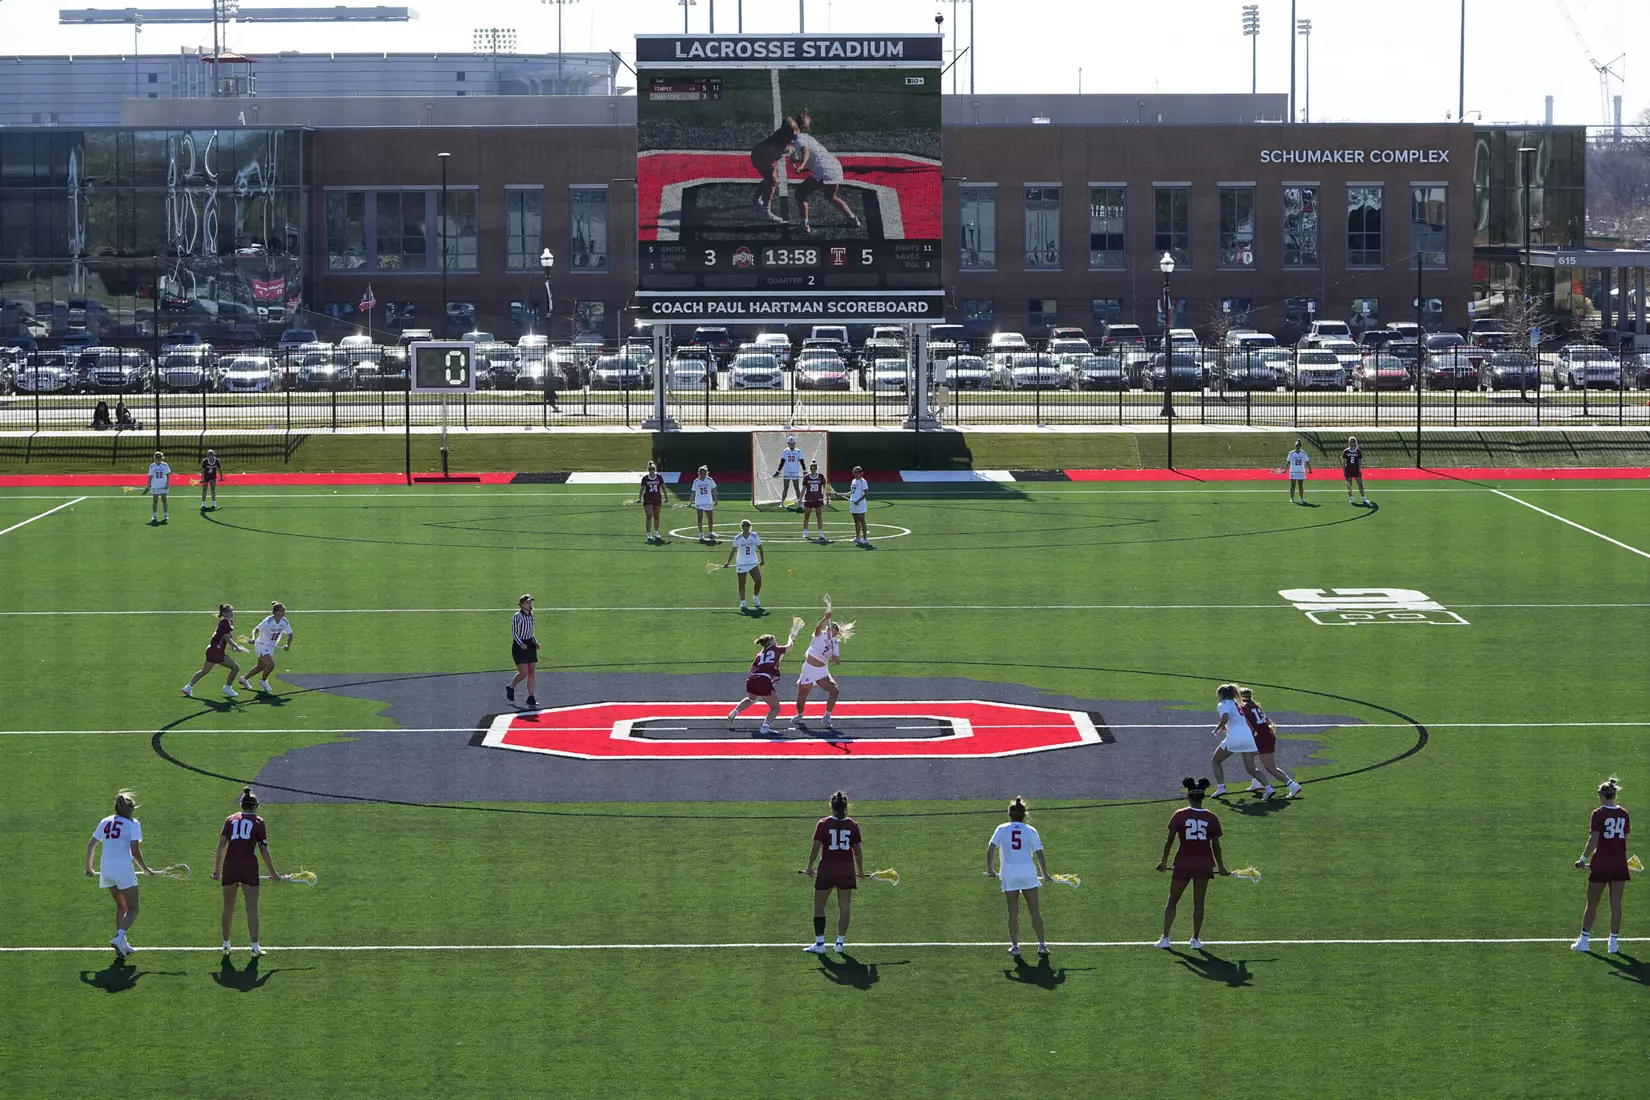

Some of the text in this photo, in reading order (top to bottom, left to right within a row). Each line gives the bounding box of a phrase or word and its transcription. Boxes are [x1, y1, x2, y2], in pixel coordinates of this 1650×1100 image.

[676, 41, 904, 58] LACROSSE STADIUM
[1260, 150, 1450, 164] SCHUMAKER COMPLEX
[704, 250, 716, 265] 3
[766, 250, 817, 265] 13:58
[830, 248, 846, 266] T
[862, 248, 874, 265] 5
[1558, 256, 1576, 264] 615
[808, 276, 815, 285] 2
[652, 301, 929, 314] COACH PAUL HARTMAN SCOREBOARD
[445, 350, 465, 385] 0
[745, 547, 750, 555] 2
[758, 650, 776, 665] 12
[103, 820, 123, 839] 45
[231, 819, 253, 840] 10
[1184, 818, 1208, 840] 25
[1603, 817, 1625, 839] 34
[828, 828, 851, 851] 15
[1011, 830, 1022, 850] 5
